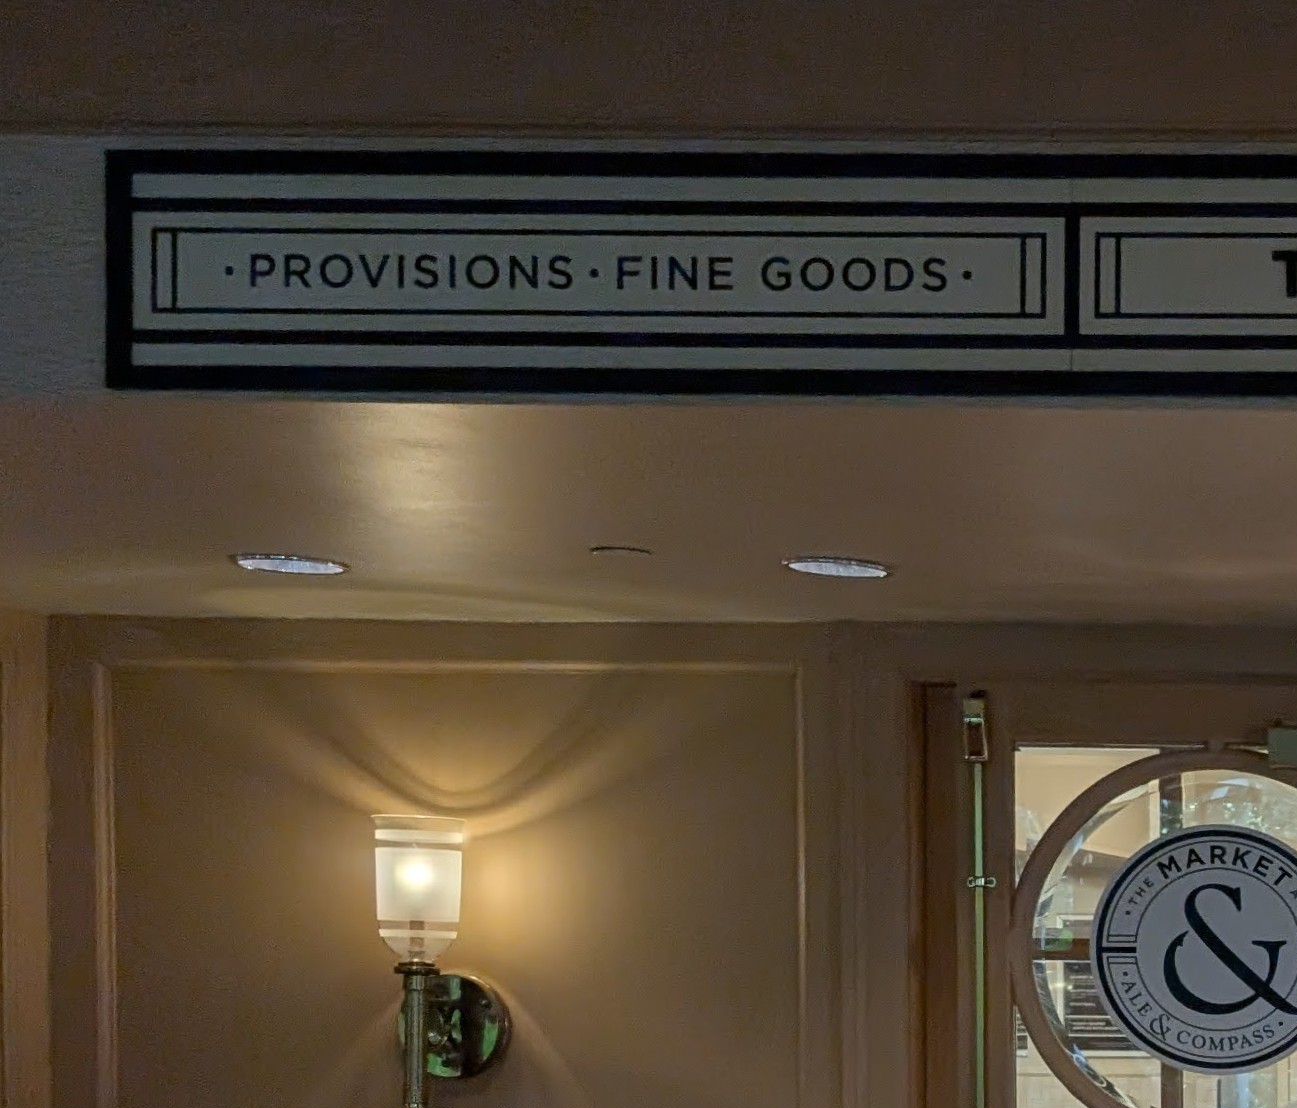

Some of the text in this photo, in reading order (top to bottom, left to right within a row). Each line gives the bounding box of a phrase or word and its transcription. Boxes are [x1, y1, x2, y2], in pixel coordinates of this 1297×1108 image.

[247, 252, 949, 294] PROVISIONS FINE GOODS
[1128, 877, 1154, 906] THE
[1156, 844, 1293, 887] MARKET
[1120, 978, 1153, 1018] ALE
[1149, 1012, 1171, 1042] &
[1176, 1023, 1276, 1052] COMPASS
